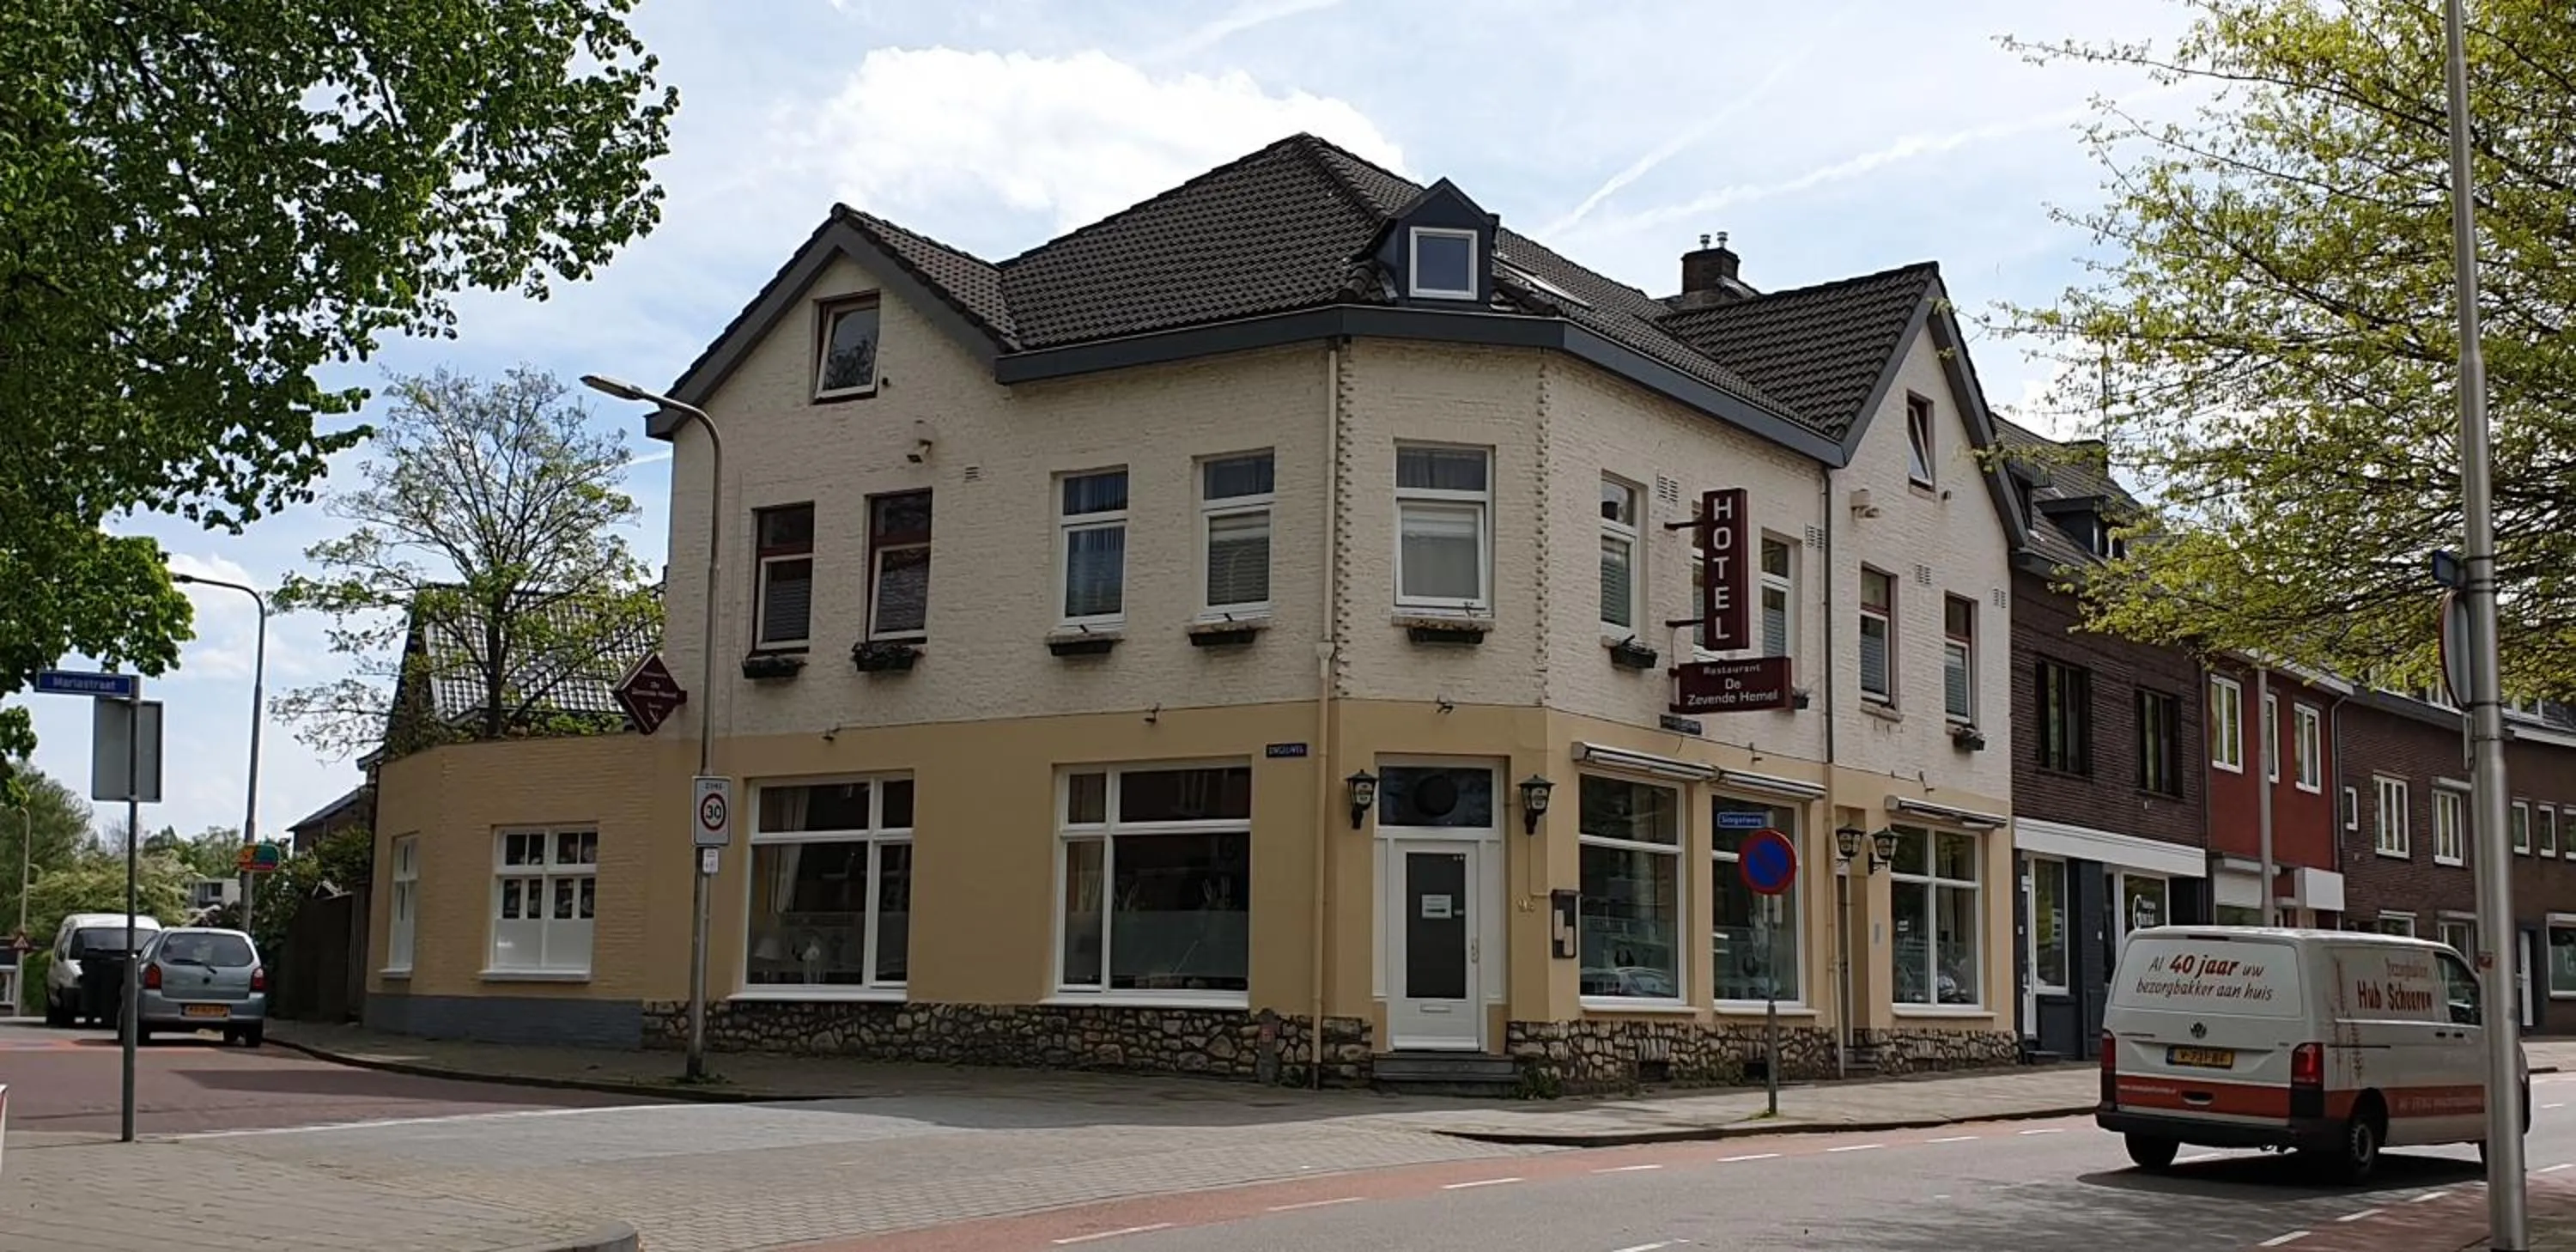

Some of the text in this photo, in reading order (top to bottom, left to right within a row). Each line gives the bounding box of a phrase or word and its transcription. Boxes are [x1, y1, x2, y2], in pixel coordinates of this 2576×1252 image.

[1712, 495, 1732, 640] HOTEL
[1703, 664, 1760, 675] Restaurant
[52, 675, 117, 690] Mariastraat
[1724, 678, 1742, 690] De
[1687, 689, 1779, 706] Zevende Hemel
[706, 804, 722, 819] 30
[2148, 954, 2265, 979] Al 40 jaar uw
[2136, 977, 2275, 1000] bezorgbakker aan huis
[2357, 980, 2382, 1009] Hub
